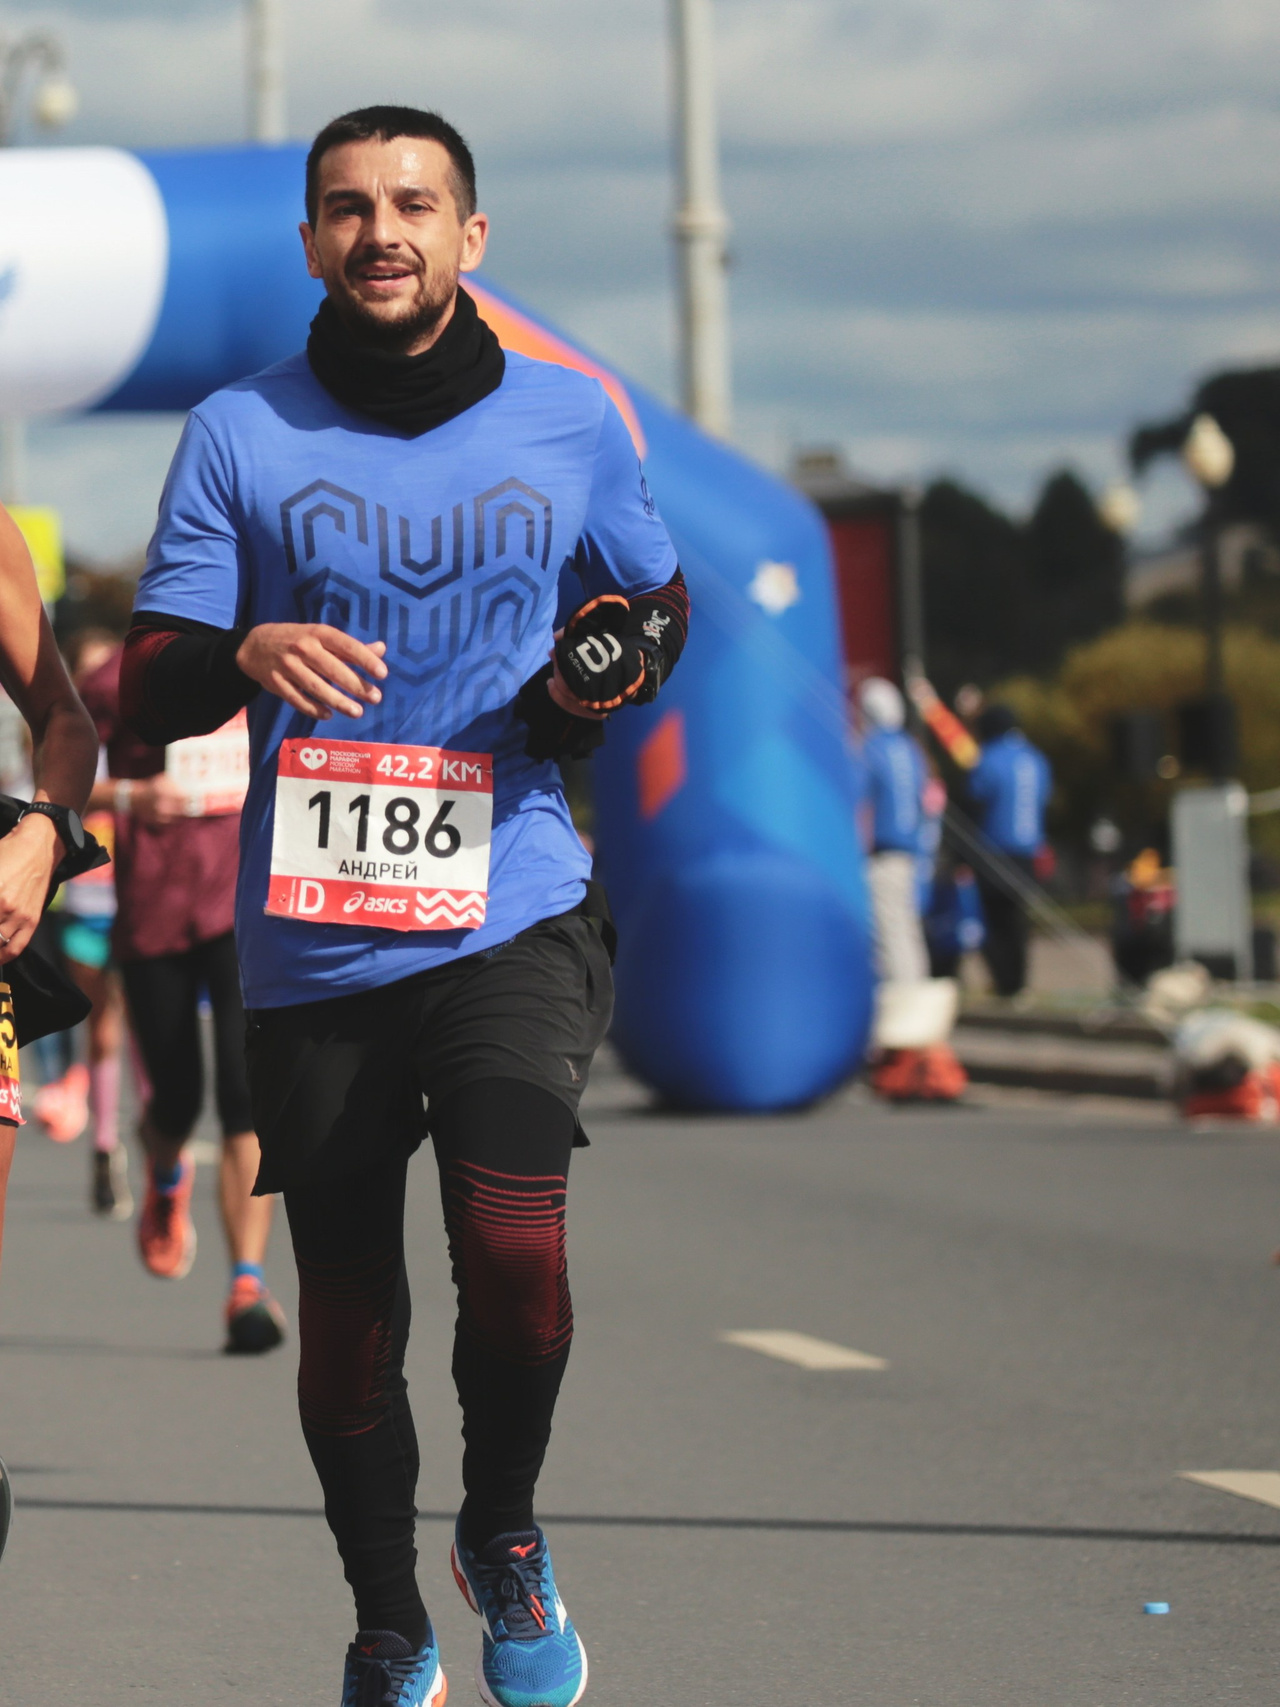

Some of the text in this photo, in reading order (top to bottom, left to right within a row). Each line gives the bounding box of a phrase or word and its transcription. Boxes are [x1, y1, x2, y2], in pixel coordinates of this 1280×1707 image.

[376, 754, 433, 781] 42,2
[308, 790, 461, 858] 1186
[338, 859, 418, 880] АНДРЕЙ
[297, 879, 326, 914] D
[363, 896, 408, 914] asics
